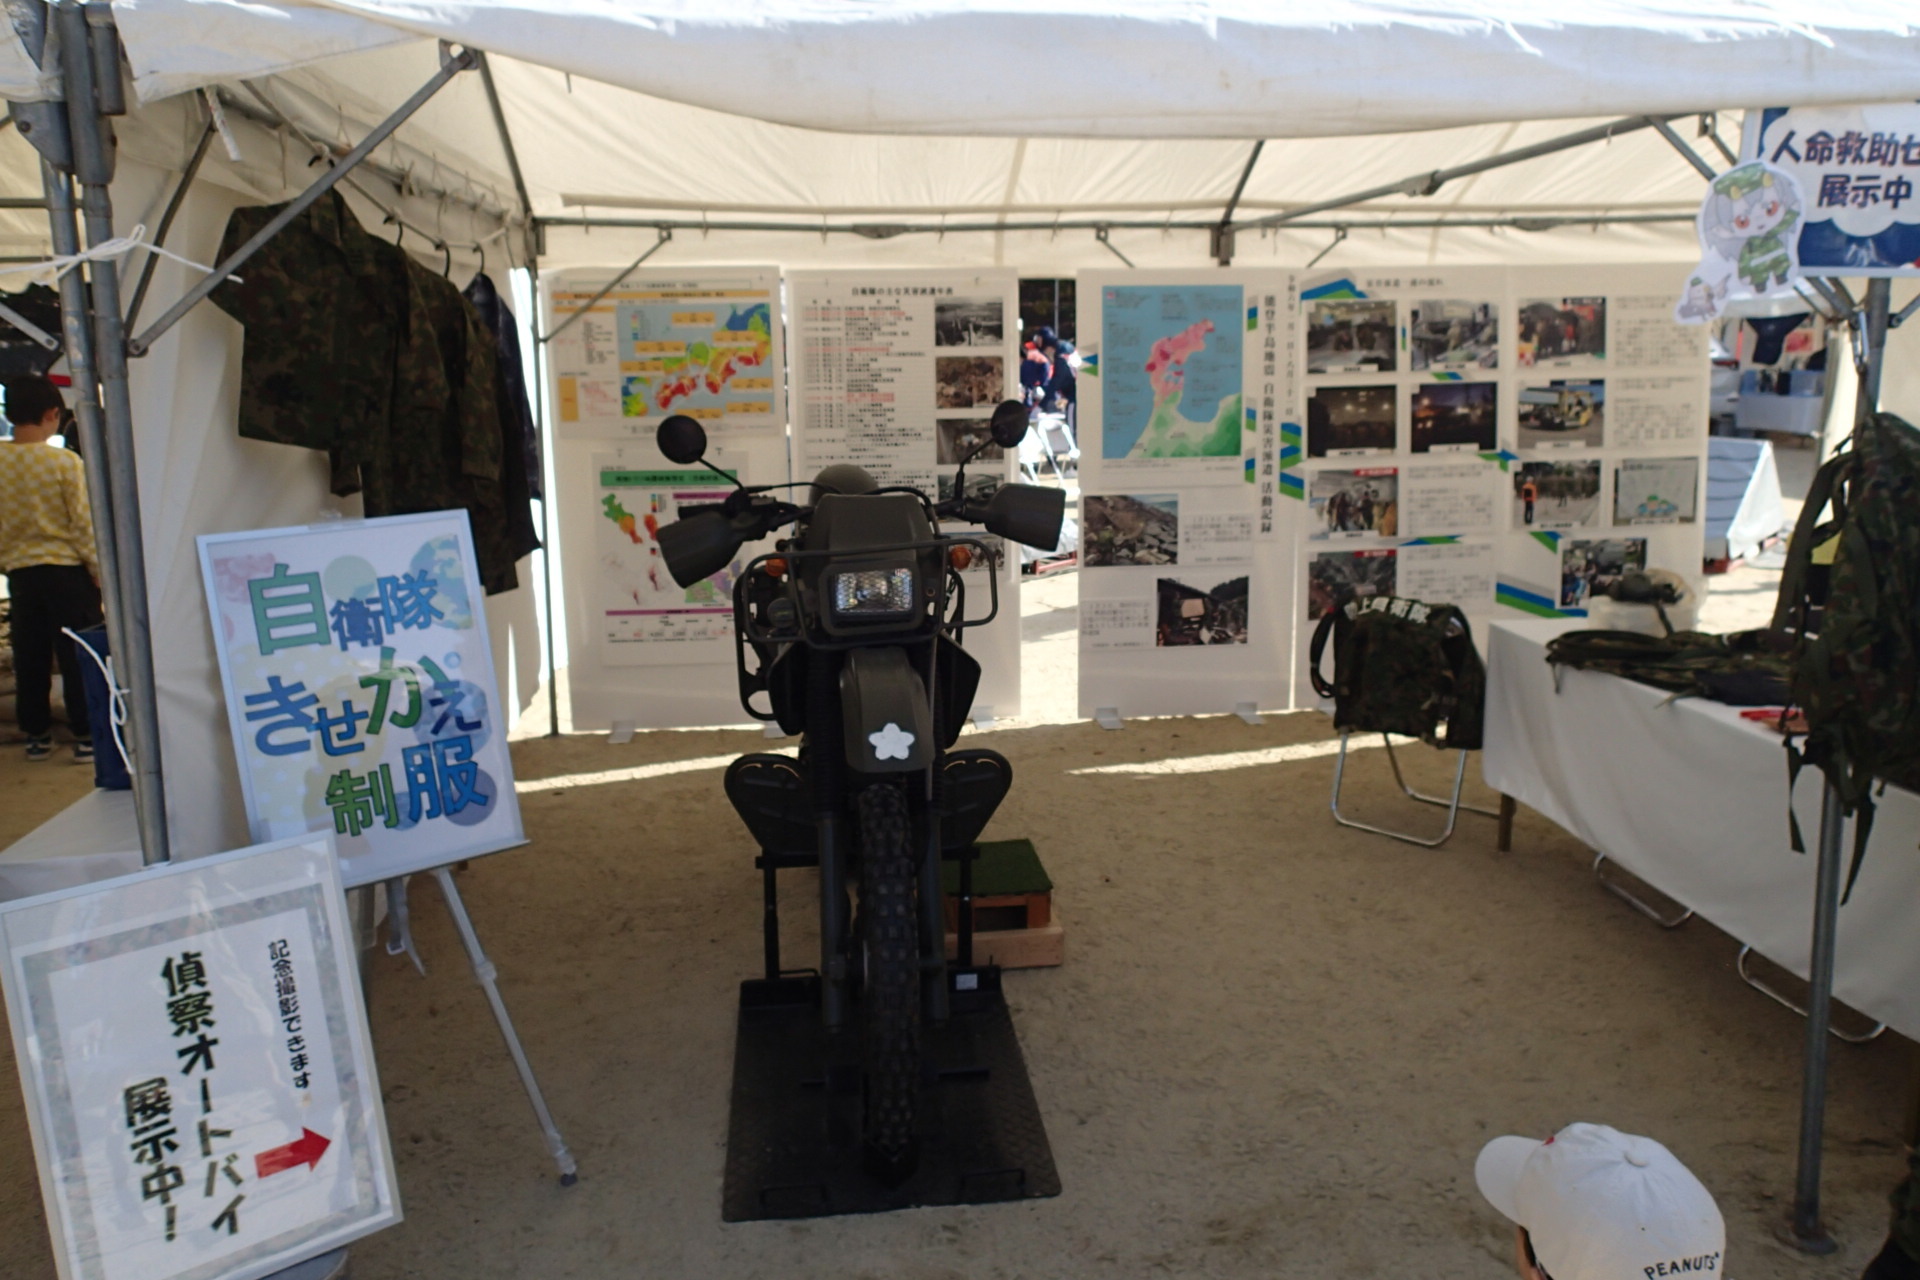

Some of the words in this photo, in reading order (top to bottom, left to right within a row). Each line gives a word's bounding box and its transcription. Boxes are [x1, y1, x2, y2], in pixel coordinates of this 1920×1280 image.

[1817, 174, 1913, 210] 展示中
[247, 562, 446, 656] 自衛隊
[244, 646, 483, 757] きせかえ
[324, 736, 490, 838] 制服
[268, 938, 311, 1090] 記念撮影できます
[160, 951, 247, 1236] 偵察オートバイ
[122, 1076, 185, 1242] 展示中！
[1643, 1254, 1717, 1280] PEANUTS
